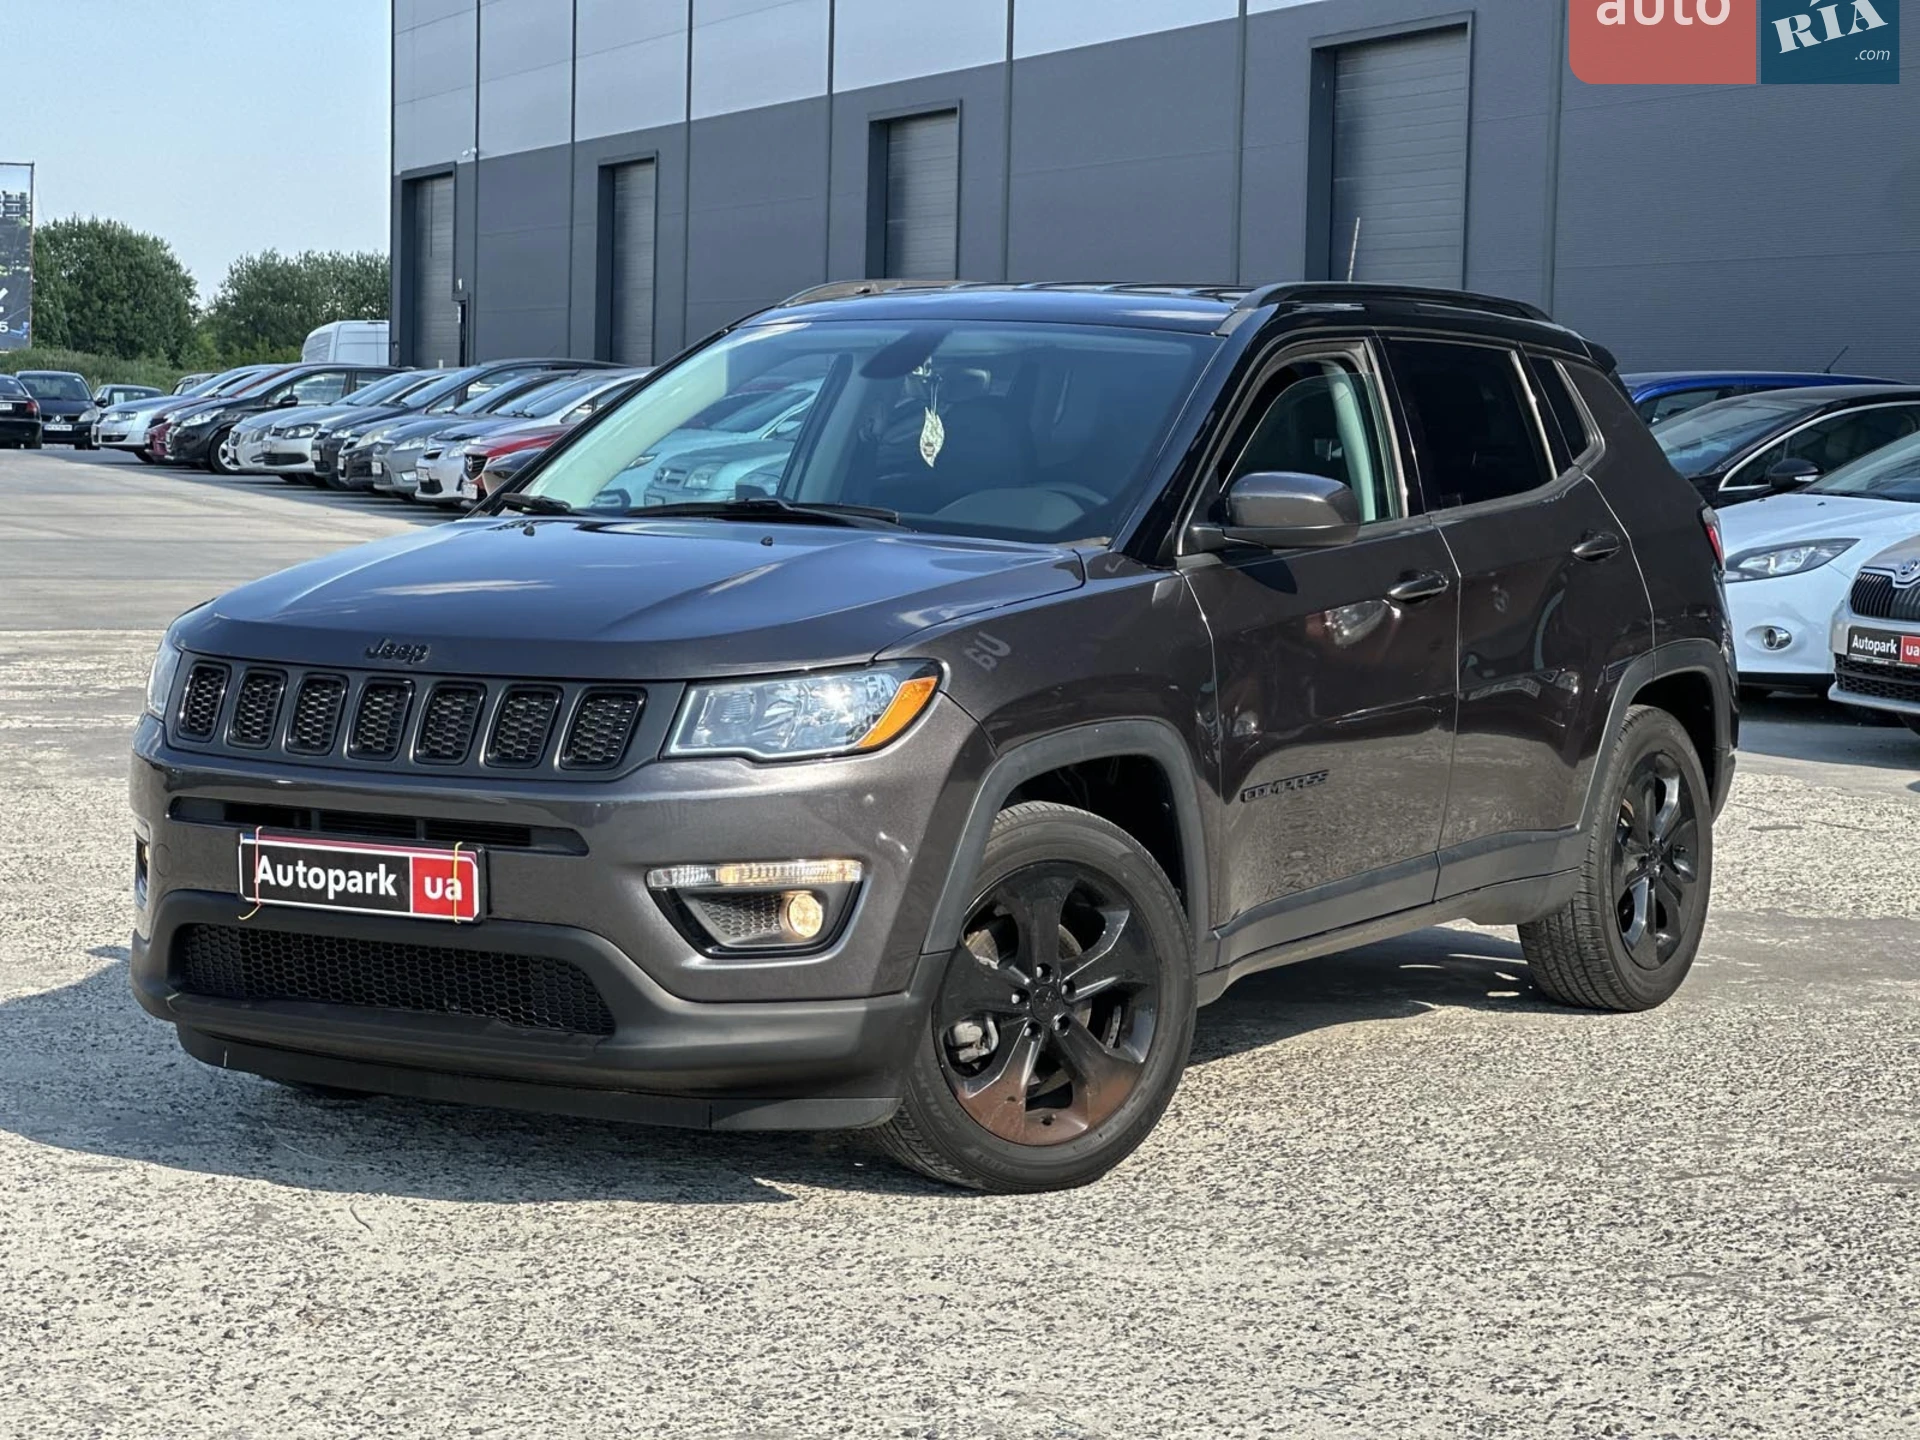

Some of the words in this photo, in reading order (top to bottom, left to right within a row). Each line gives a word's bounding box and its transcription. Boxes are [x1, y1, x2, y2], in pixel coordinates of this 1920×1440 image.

[364, 638, 432, 666] Jeep
[1852, 634, 1897, 655] Autopark
[1906, 644, 1920, 656] ua
[257, 854, 398, 900] Autopark
[423, 876, 463, 901] ua
